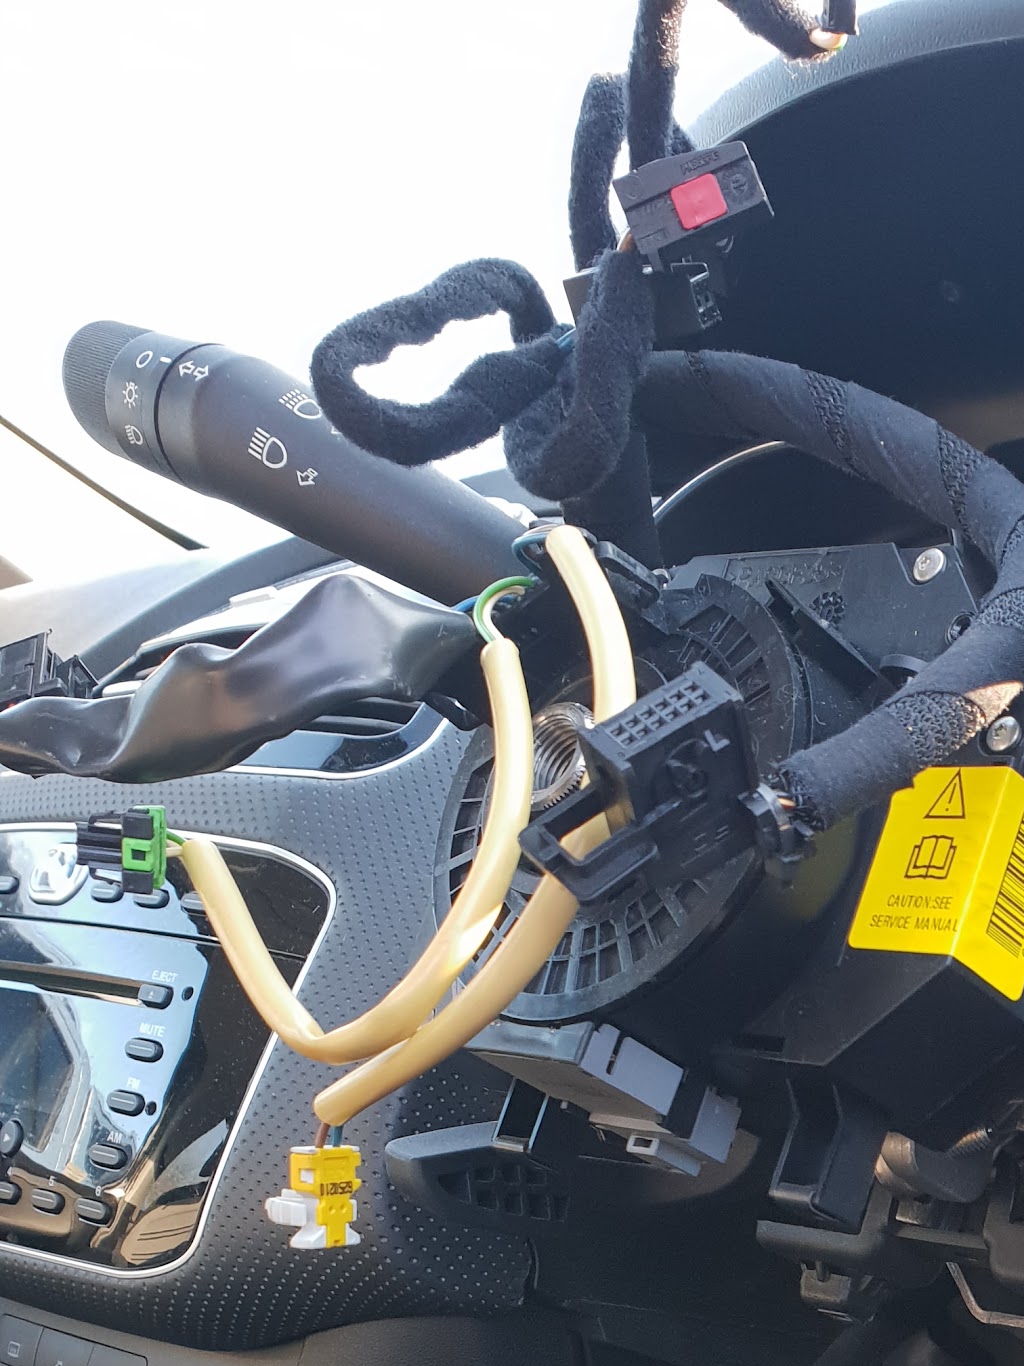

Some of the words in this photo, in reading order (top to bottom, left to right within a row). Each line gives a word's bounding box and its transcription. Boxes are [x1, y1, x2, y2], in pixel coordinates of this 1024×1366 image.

[869, 914, 912, 930] SERVICE
[913, 916, 959, 932] MANUAL
[152, 970, 177, 983] EJECT
[139, 1022, 166, 1038] MUTE
[127, 1077, 141, 1090] FM
[106, 1130, 123, 1144] AM
[48, 1175, 57, 1187] 5
[94, 1185, 102, 1197] 6
